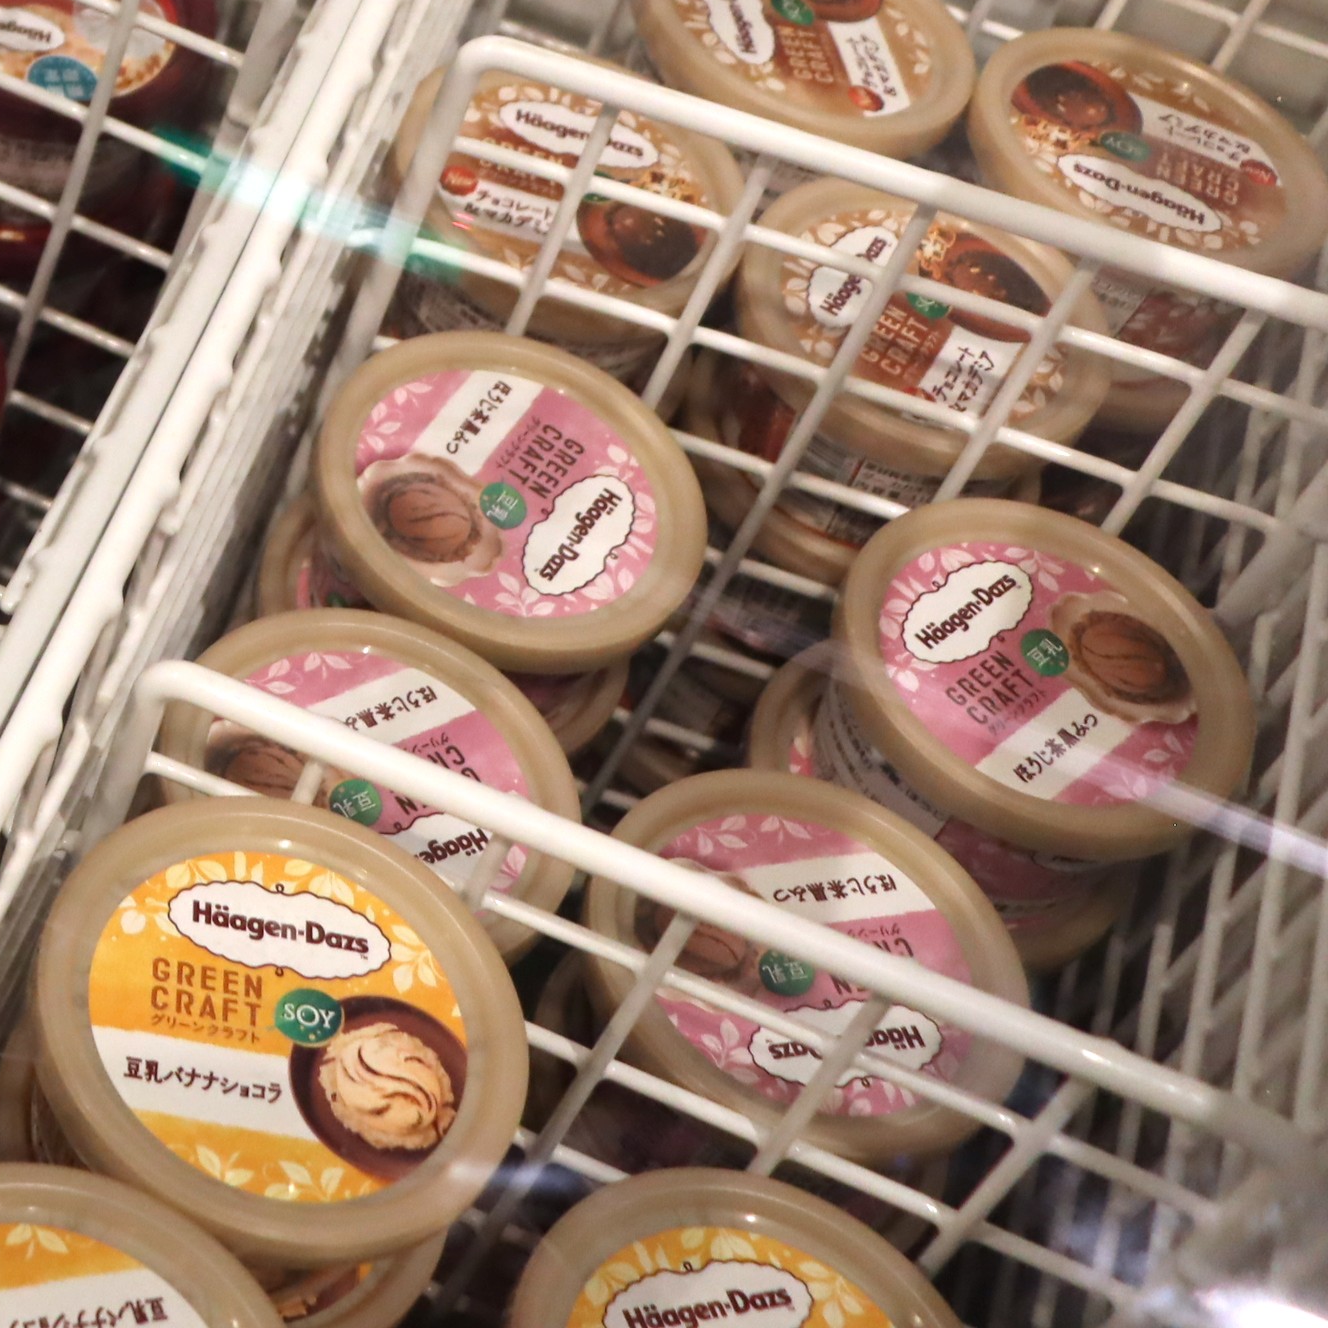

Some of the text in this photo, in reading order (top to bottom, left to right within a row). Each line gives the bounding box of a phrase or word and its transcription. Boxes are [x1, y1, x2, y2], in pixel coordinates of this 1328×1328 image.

[508, 424, 563, 487] CRAFT
[528, 438, 585, 500] GREEN
[539, 487, 623, 582] Häagen-Dazs
[913, 574, 1017, 650] Häagen-Dazs
[945, 650, 1015, 706] GREEN
[965, 668, 1034, 725] CRAFT
[344, 685, 438, 732] ほうじ茶黒み
[1012, 713, 1099, 784] ほうじ茶黒みつ
[772, 873, 898, 903] ほうじ茶黒みつ
[192, 899, 370, 955] Häagen-Dazs
[151, 957, 263, 1001] GREEN
[150, 985, 263, 1028] CRAFT
[150, 1013, 261, 1045] グリーンクラフト
[282, 1003, 336, 1030] SOY
[123, 1056, 283, 1104] 豆乳バナナショコラ
[622, 1287, 793, 1328] Häagen-Dazs
